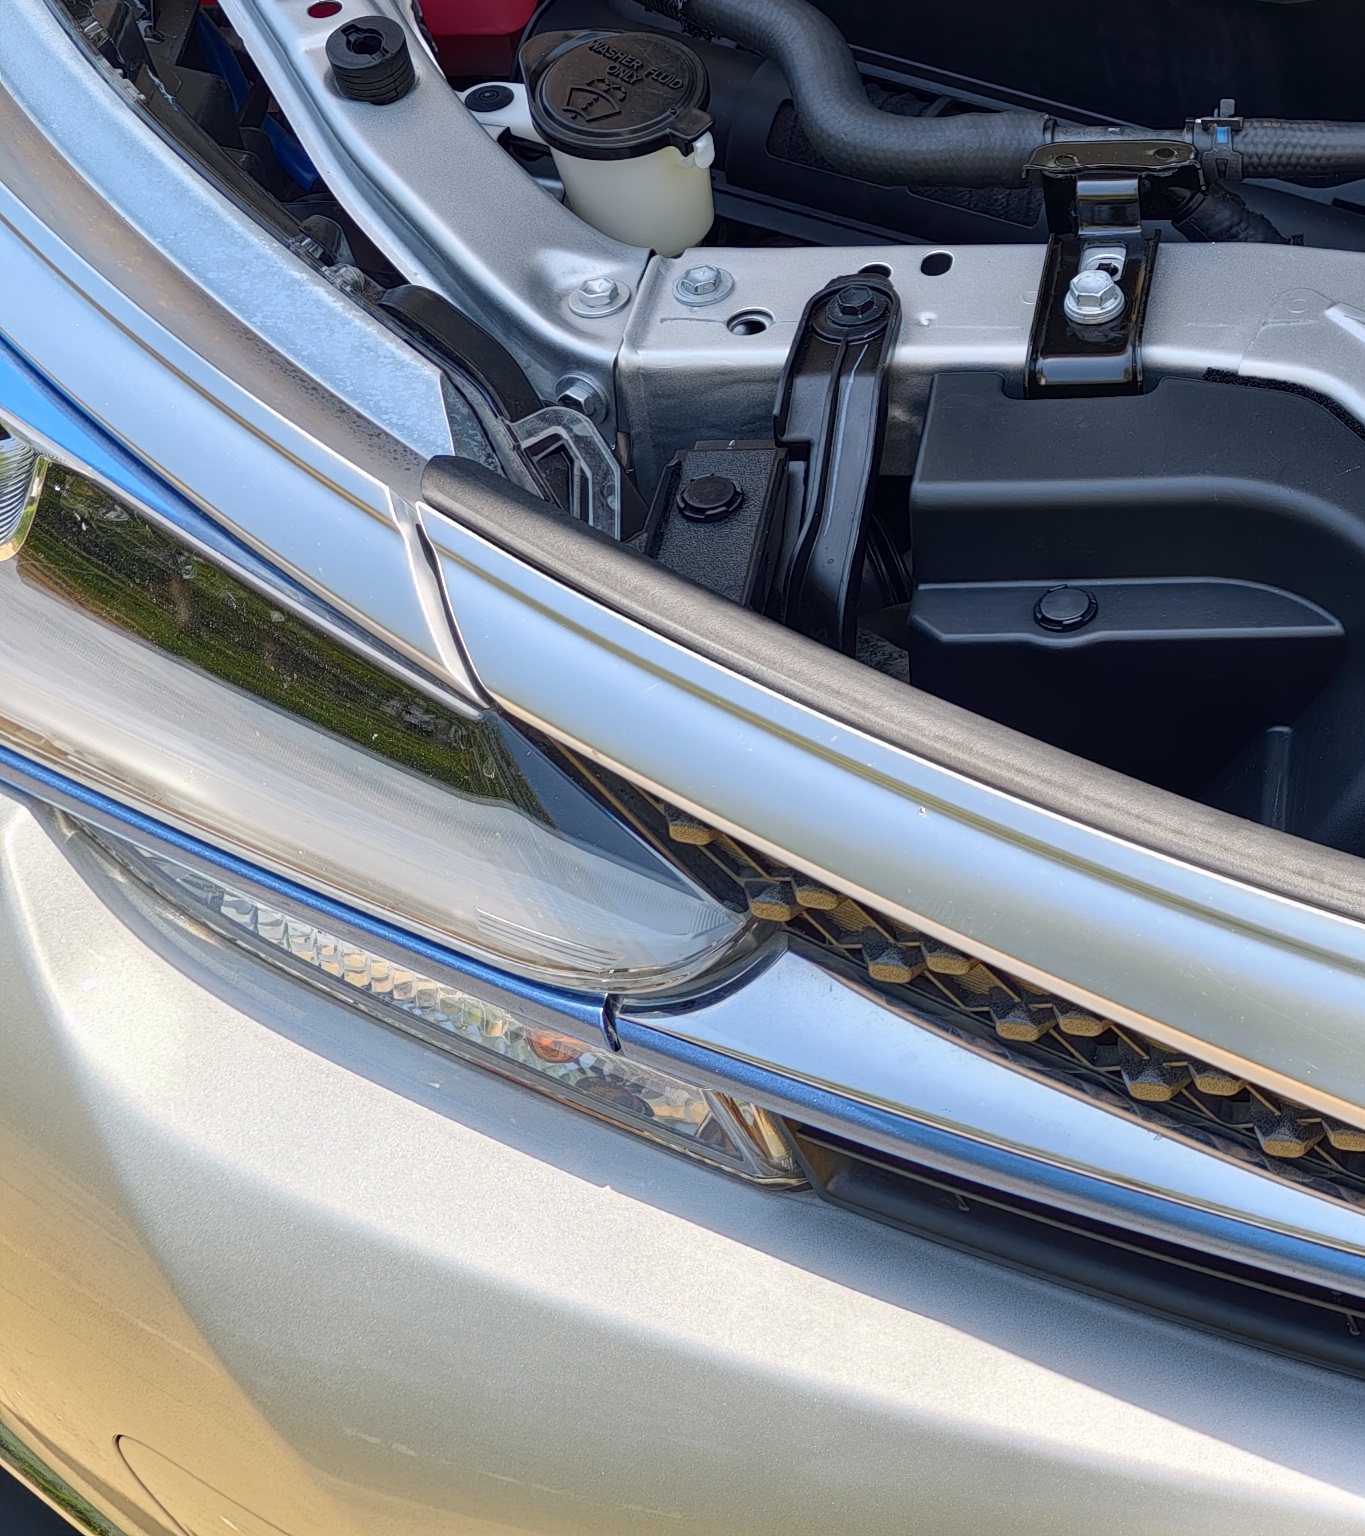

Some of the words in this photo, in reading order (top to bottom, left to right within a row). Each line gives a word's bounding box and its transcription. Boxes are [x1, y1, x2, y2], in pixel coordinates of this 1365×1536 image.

[588, 40, 643, 69] WASHER
[645, 66, 683, 89] FLUID
[606, 63, 643, 84] ONLY
